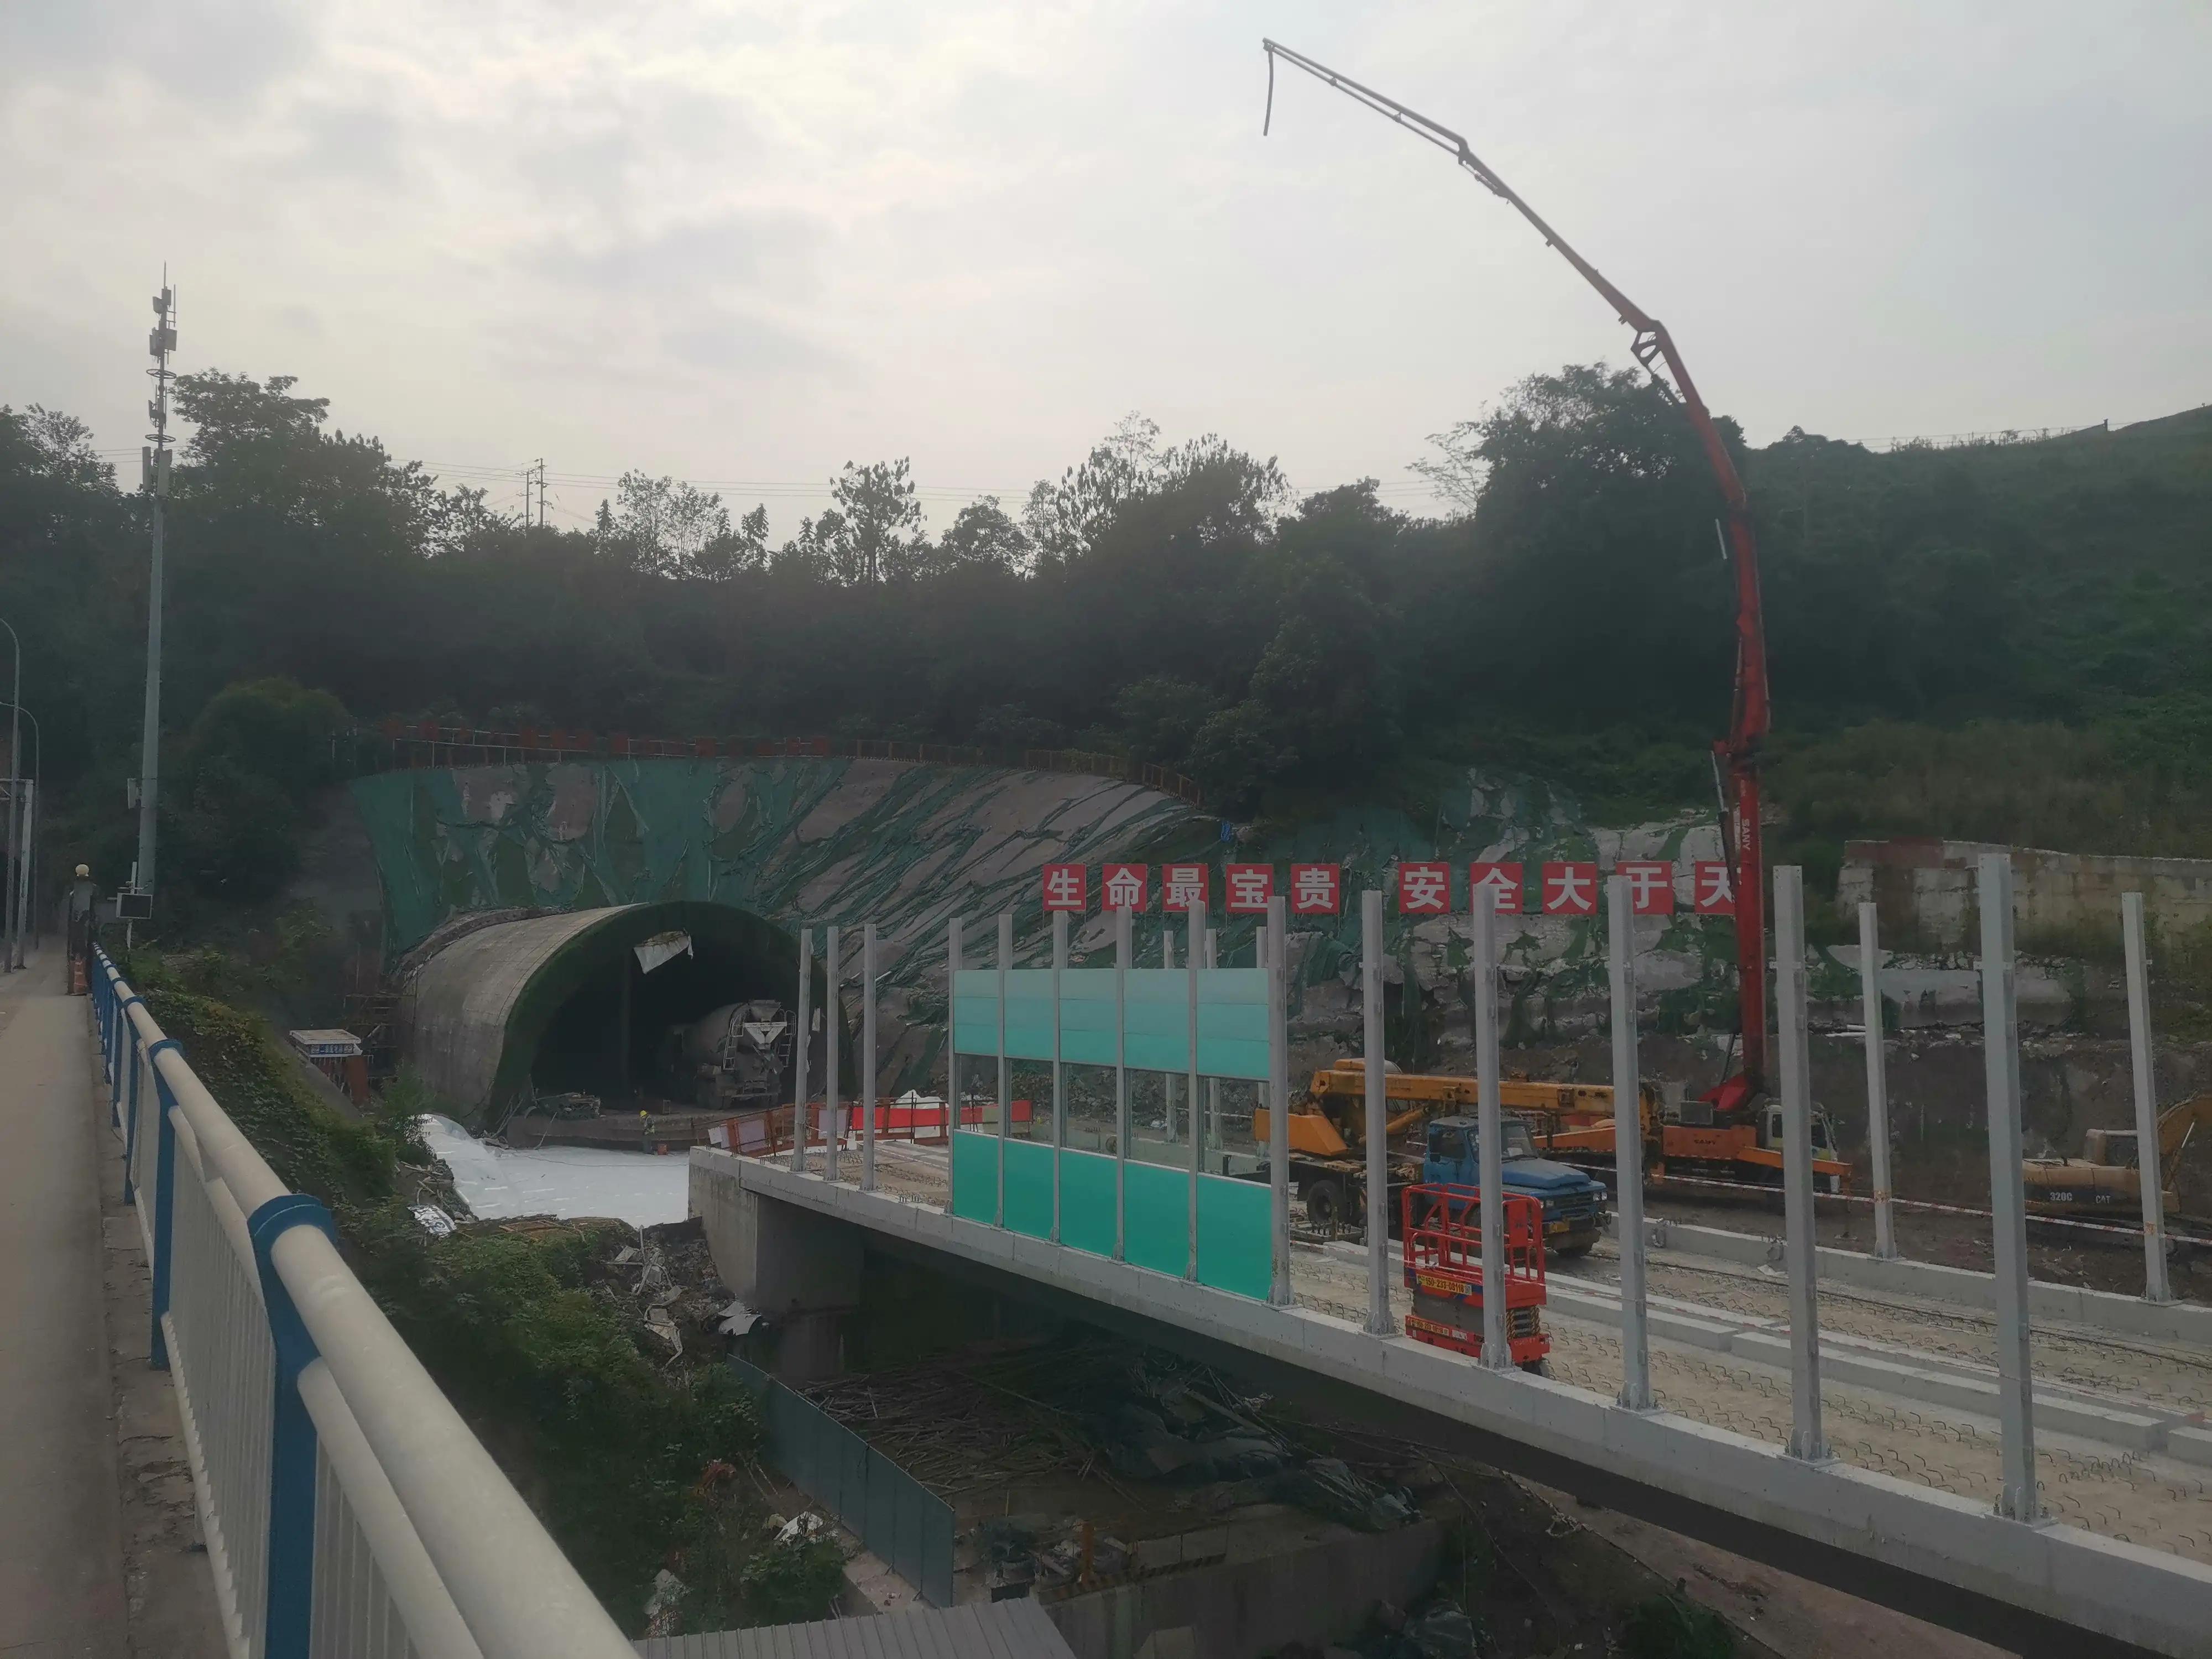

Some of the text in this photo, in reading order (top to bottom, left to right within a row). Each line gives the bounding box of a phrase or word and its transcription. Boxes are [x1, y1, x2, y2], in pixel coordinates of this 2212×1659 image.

[1741, 818, 1751, 851] SANY
[1047, 868, 1336, 909] 生命最宝贵
[2096, 1194, 2111, 1204] CAT
